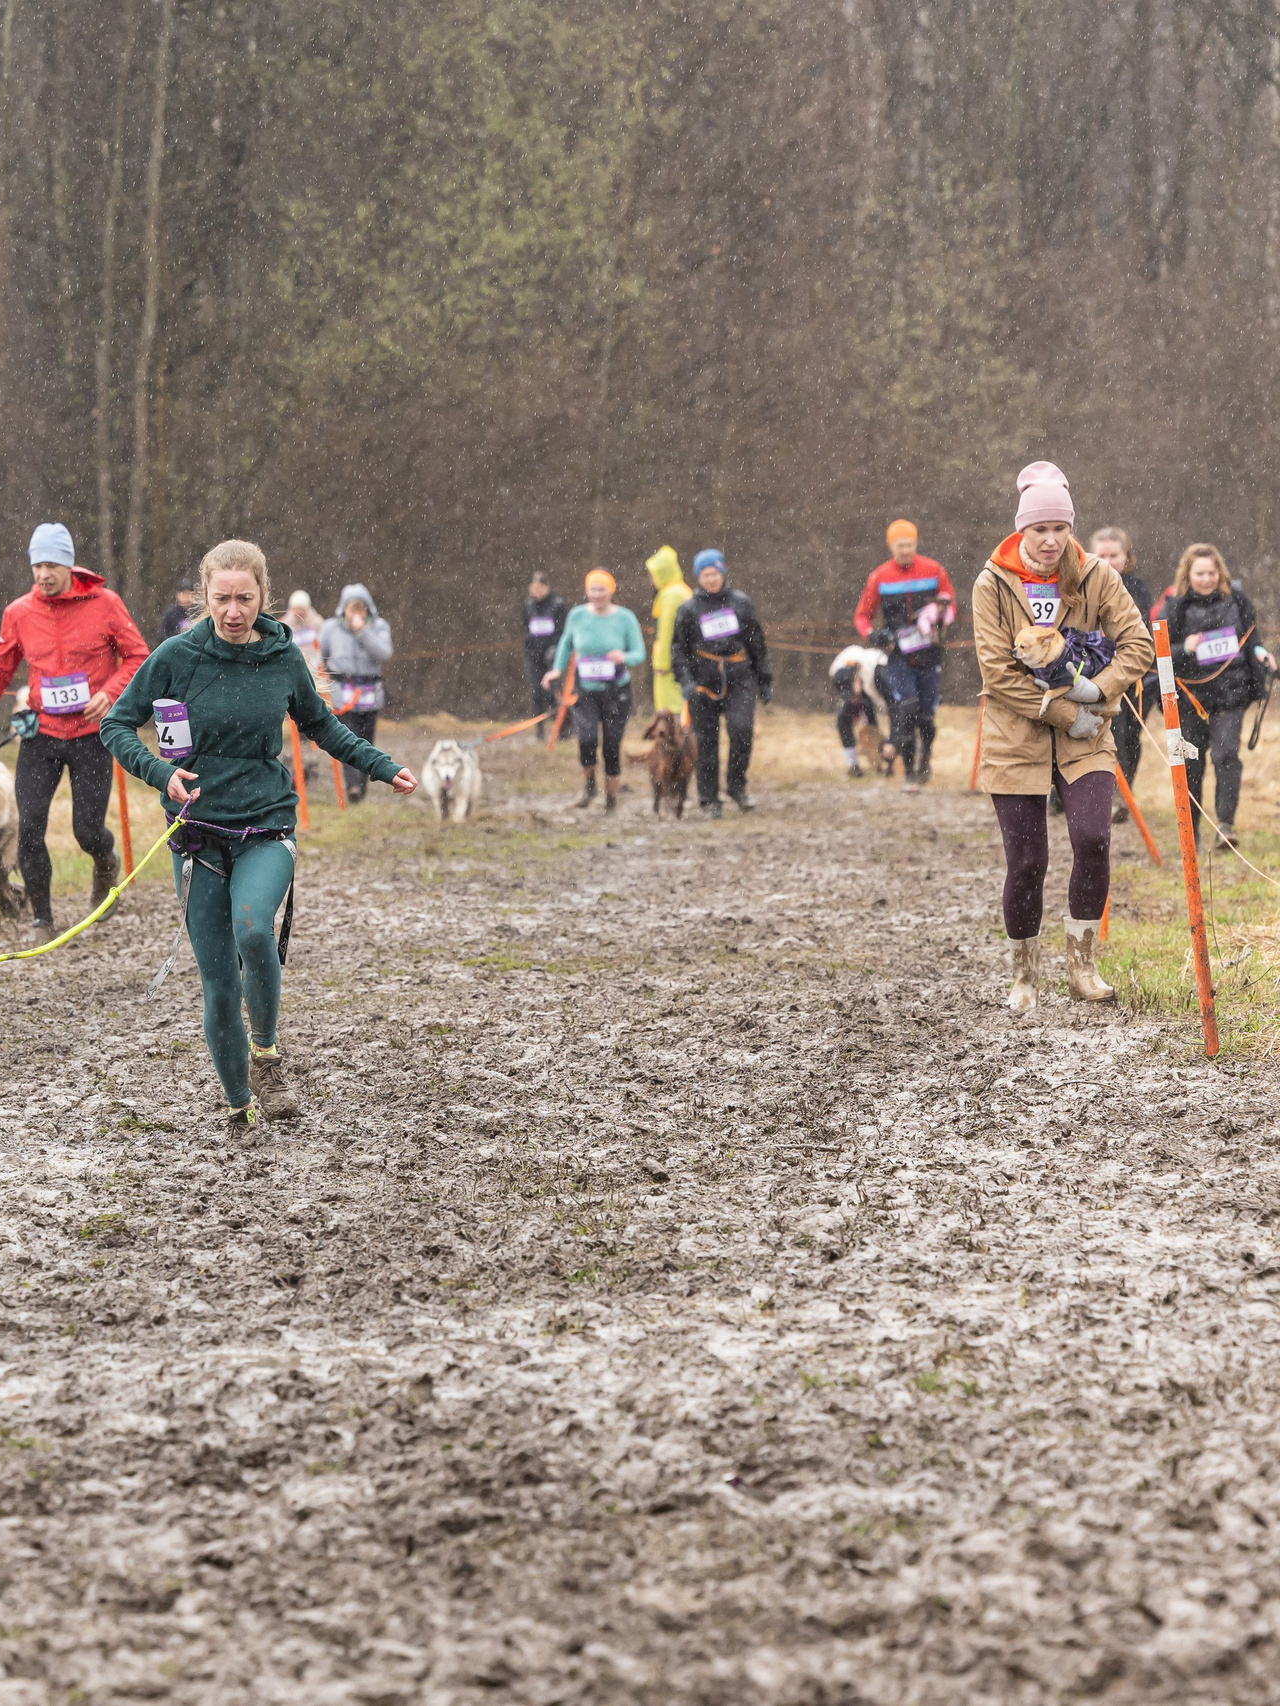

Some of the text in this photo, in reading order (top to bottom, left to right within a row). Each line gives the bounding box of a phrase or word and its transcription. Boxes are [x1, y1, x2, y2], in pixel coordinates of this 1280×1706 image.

[1032, 602, 1054, 620] 39
[1207, 641, 1229, 655] 107
[52, 688, 79, 704] 133
